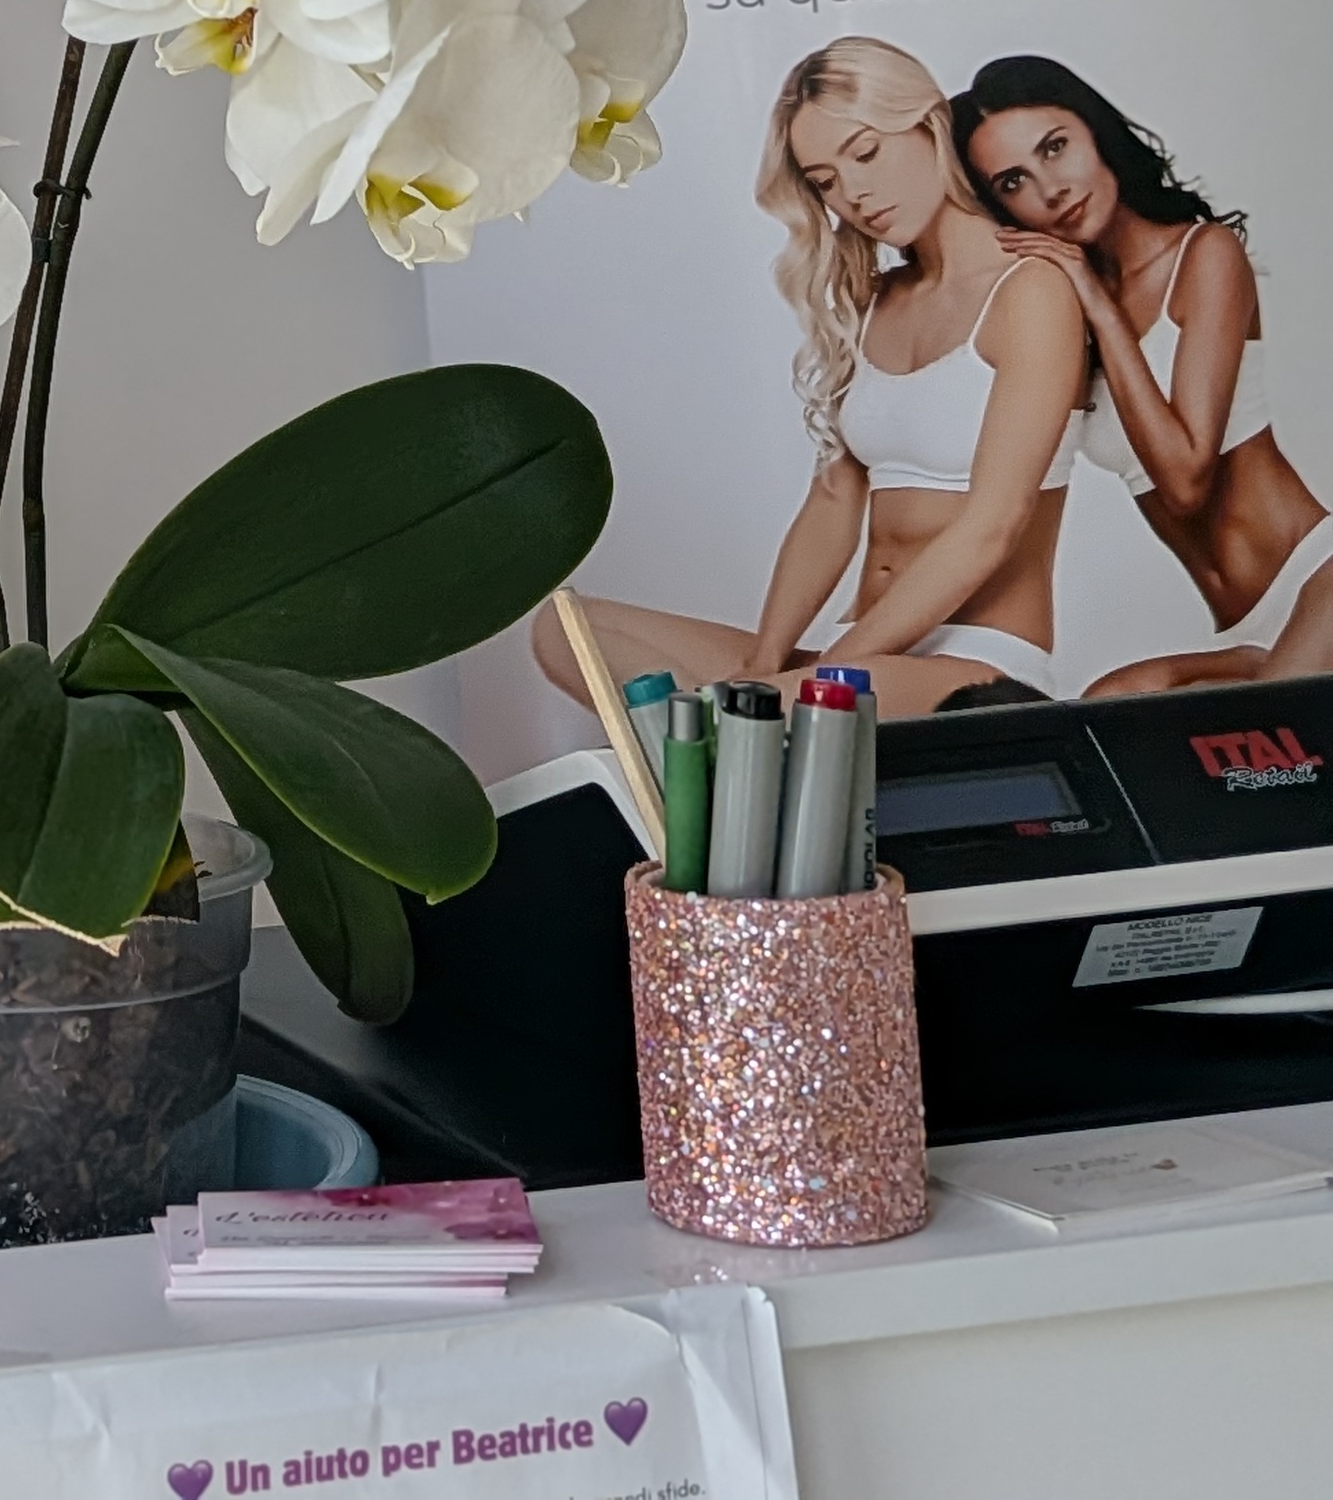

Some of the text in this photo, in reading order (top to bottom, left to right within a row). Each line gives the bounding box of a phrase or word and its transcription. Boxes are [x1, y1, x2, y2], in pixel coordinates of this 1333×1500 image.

[1189, 727, 1324, 777] ITAL
[224, 1417, 594, 1495] Un aiuto per Beatrice
[657, 1479, 706, 1500] sfide.
